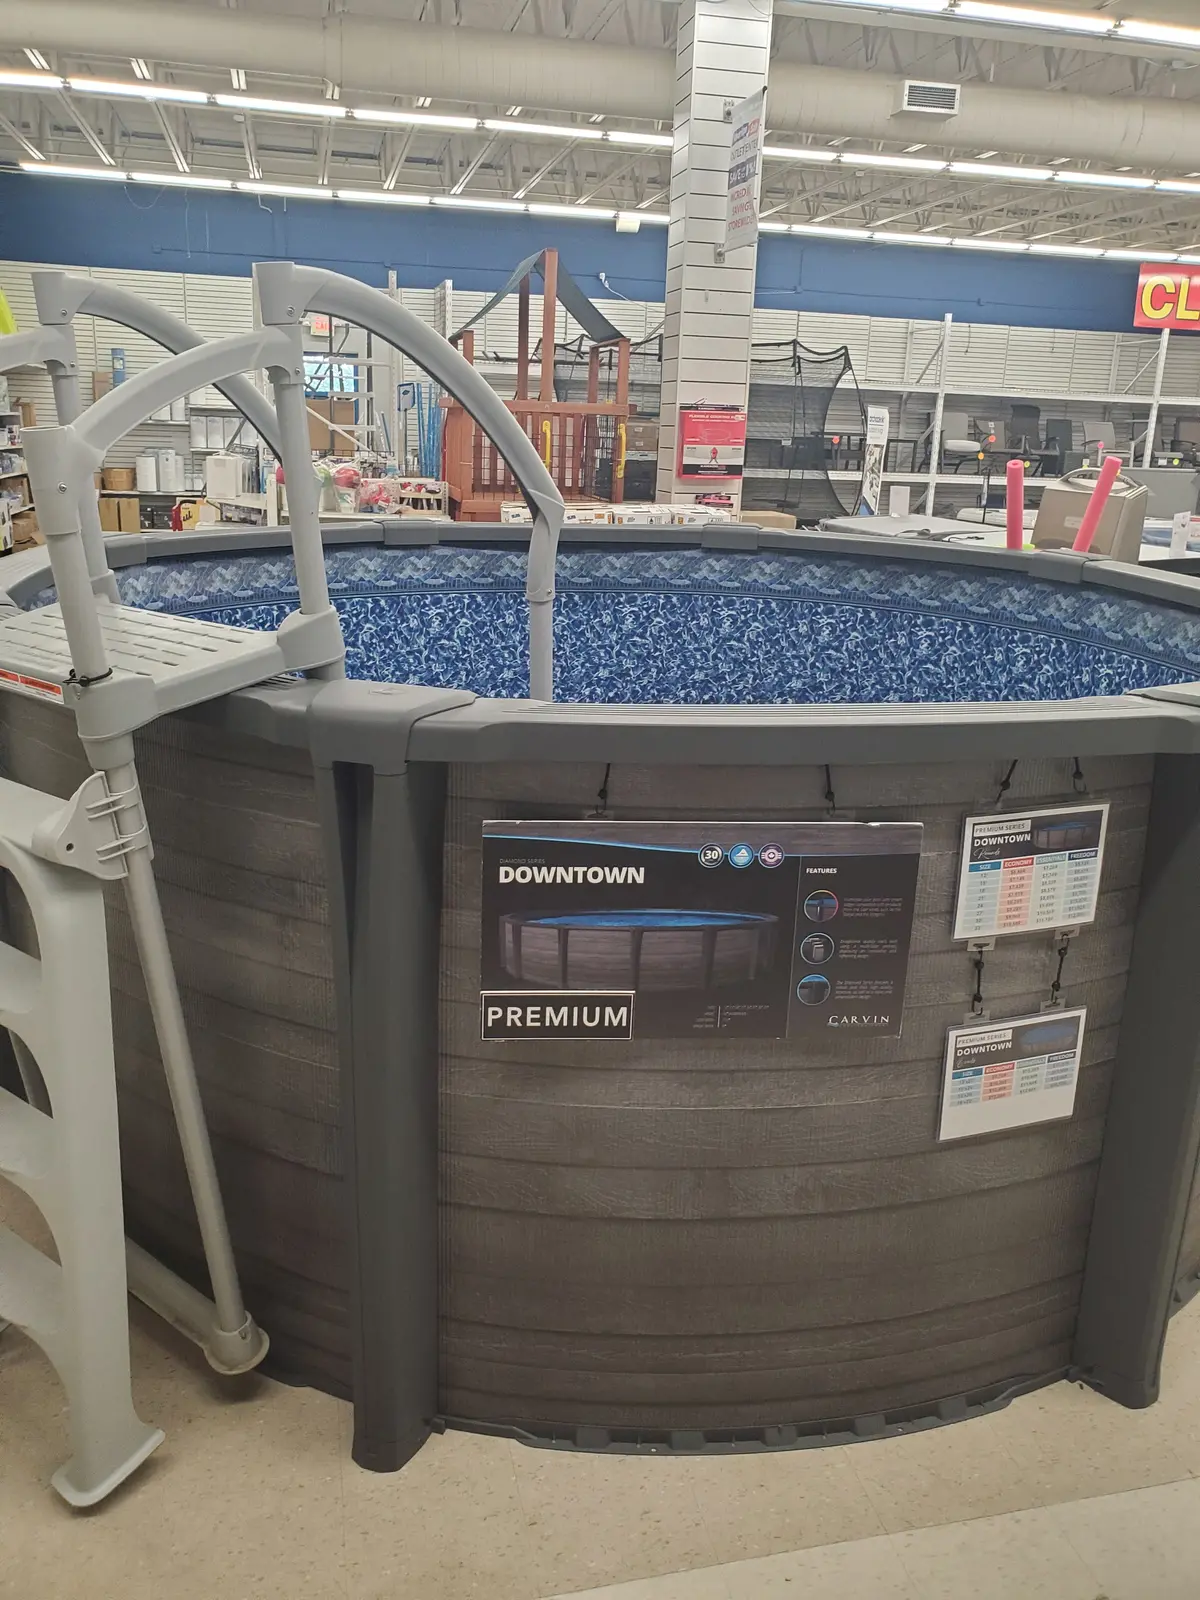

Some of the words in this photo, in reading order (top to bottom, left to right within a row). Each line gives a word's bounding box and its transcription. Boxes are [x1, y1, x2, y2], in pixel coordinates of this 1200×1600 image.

[976, 825, 1004, 833] PREMIUM
[974, 833, 1031, 847] DOWNTOWN
[704, 850, 718, 859] 30
[1070, 851, 1096, 859] FREEDOM
[1004, 858, 1033, 868] ECONOMY
[499, 866, 645, 884] DOWNTOWN
[487, 1006, 627, 1027] PREMIUM
[828, 1015, 890, 1025] CARVIN
[958, 1036, 986, 1045] PREMIUM
[987, 1032, 1007, 1040] SERIES
[956, 1041, 1012, 1057] DOWNTOWN
[986, 1063, 1014, 1073] ECONOMY
